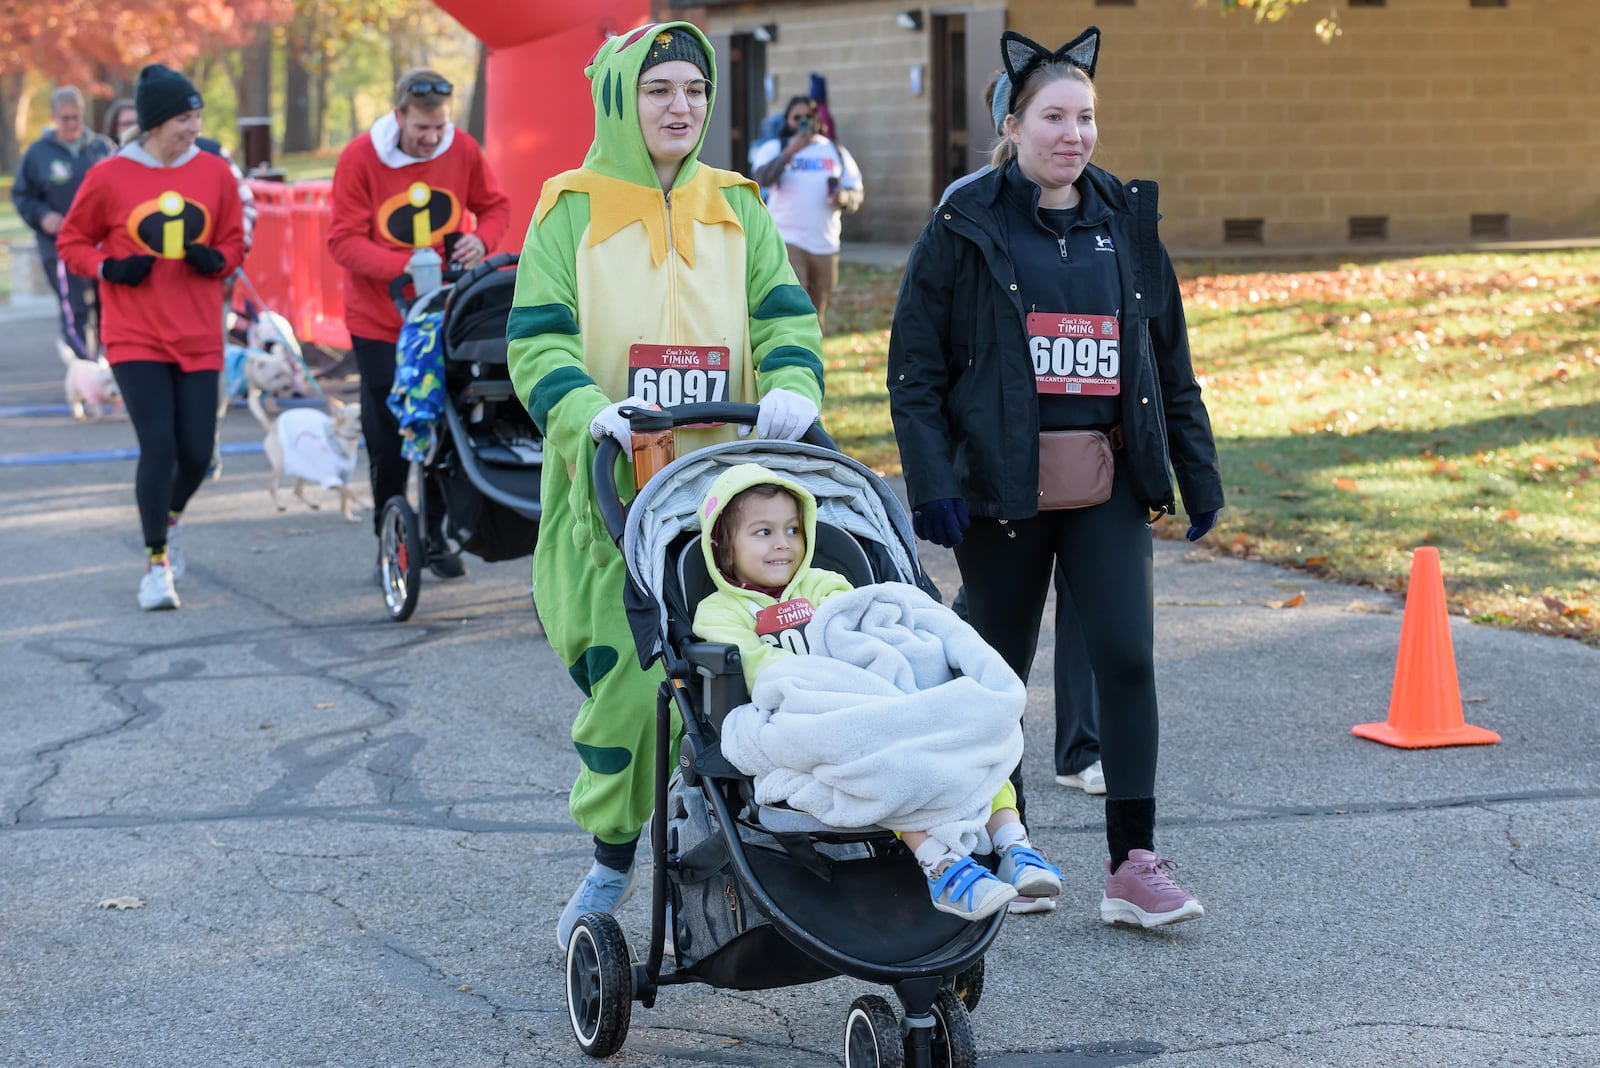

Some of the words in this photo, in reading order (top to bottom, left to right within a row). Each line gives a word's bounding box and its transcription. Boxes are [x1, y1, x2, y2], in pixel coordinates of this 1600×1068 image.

[1058, 324, 1094, 333] TIMING
[683, 349, 697, 357] Stop
[1029, 336, 1119, 378] 6095
[661, 355, 699, 364] TIMING
[634, 368, 726, 408] 6097
